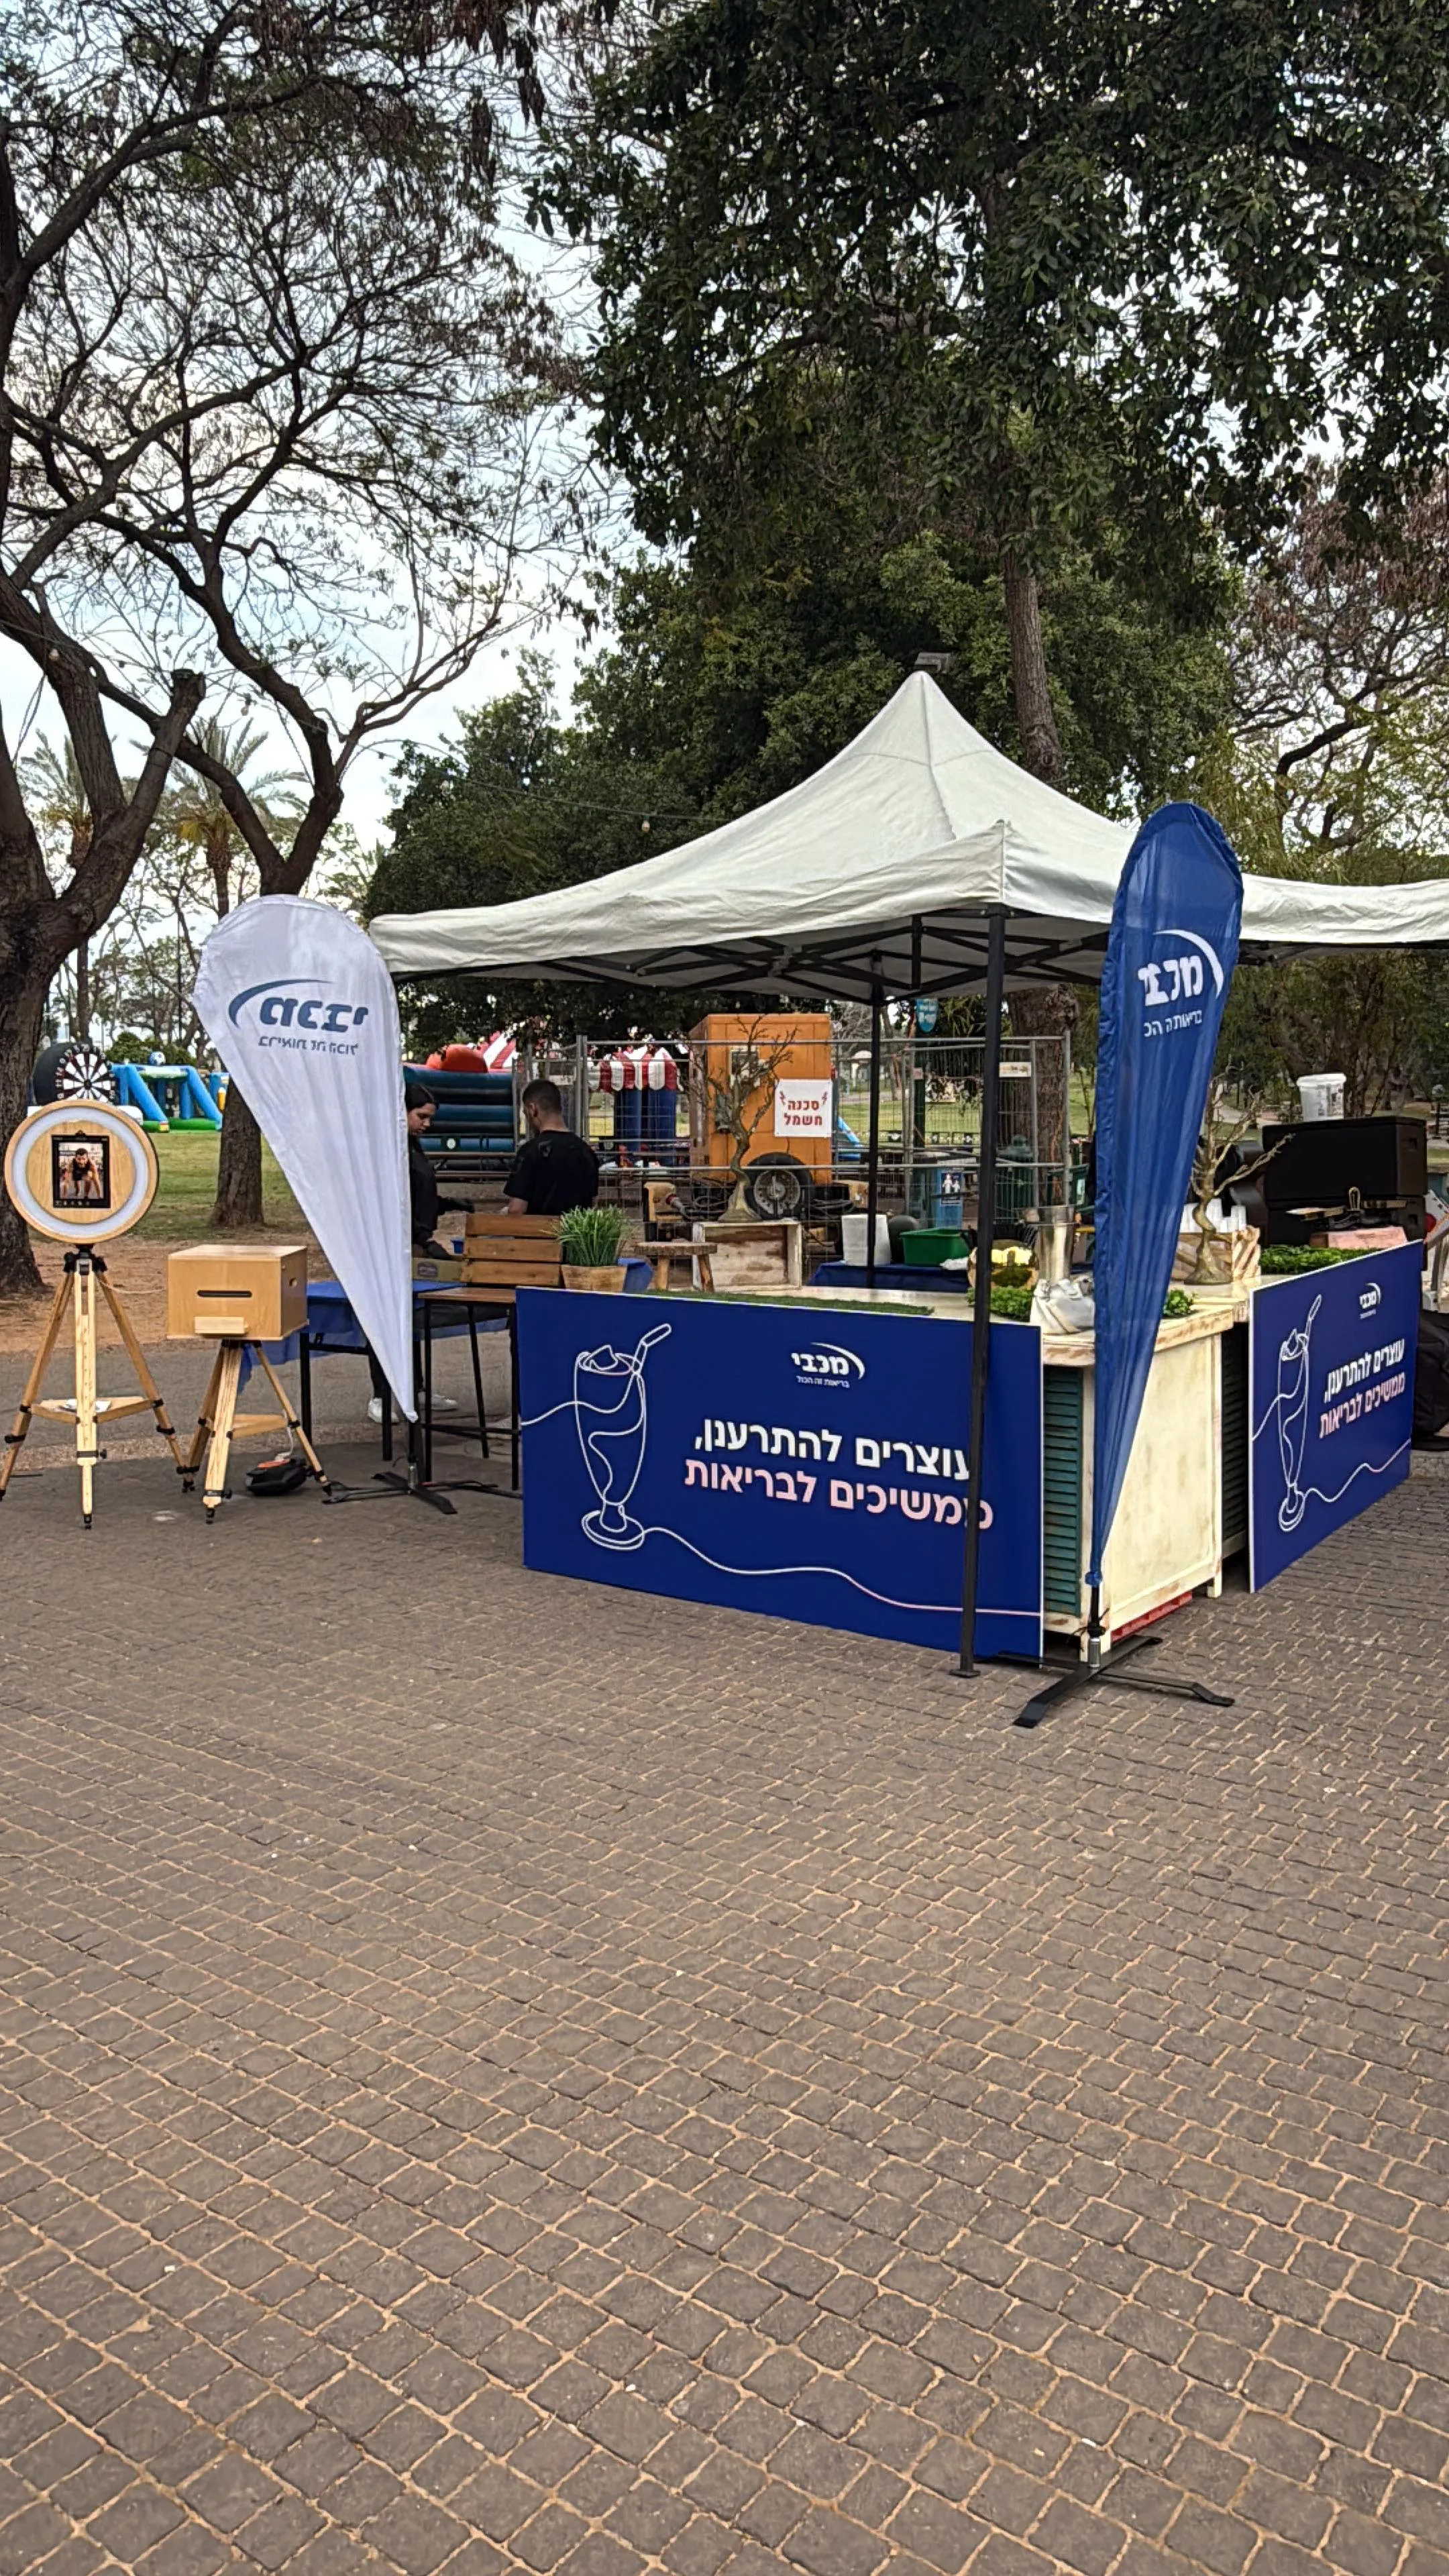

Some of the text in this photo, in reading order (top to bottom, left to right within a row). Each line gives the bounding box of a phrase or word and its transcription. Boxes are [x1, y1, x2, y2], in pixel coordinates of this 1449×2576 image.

[784, 1112, 822, 1126] חשמל
[788, 1100, 820, 1111] סכנה
[791, 1352, 849, 1375] מכבי
[1324, 1338, 1405, 1403] עוצרים להתרענן,
[1319, 1372, 1405, 1439] ממשיכים לבריאות
[694, 1419, 843, 1462] להתרענן,
[684, 1459, 817, 1503] לבריאות
